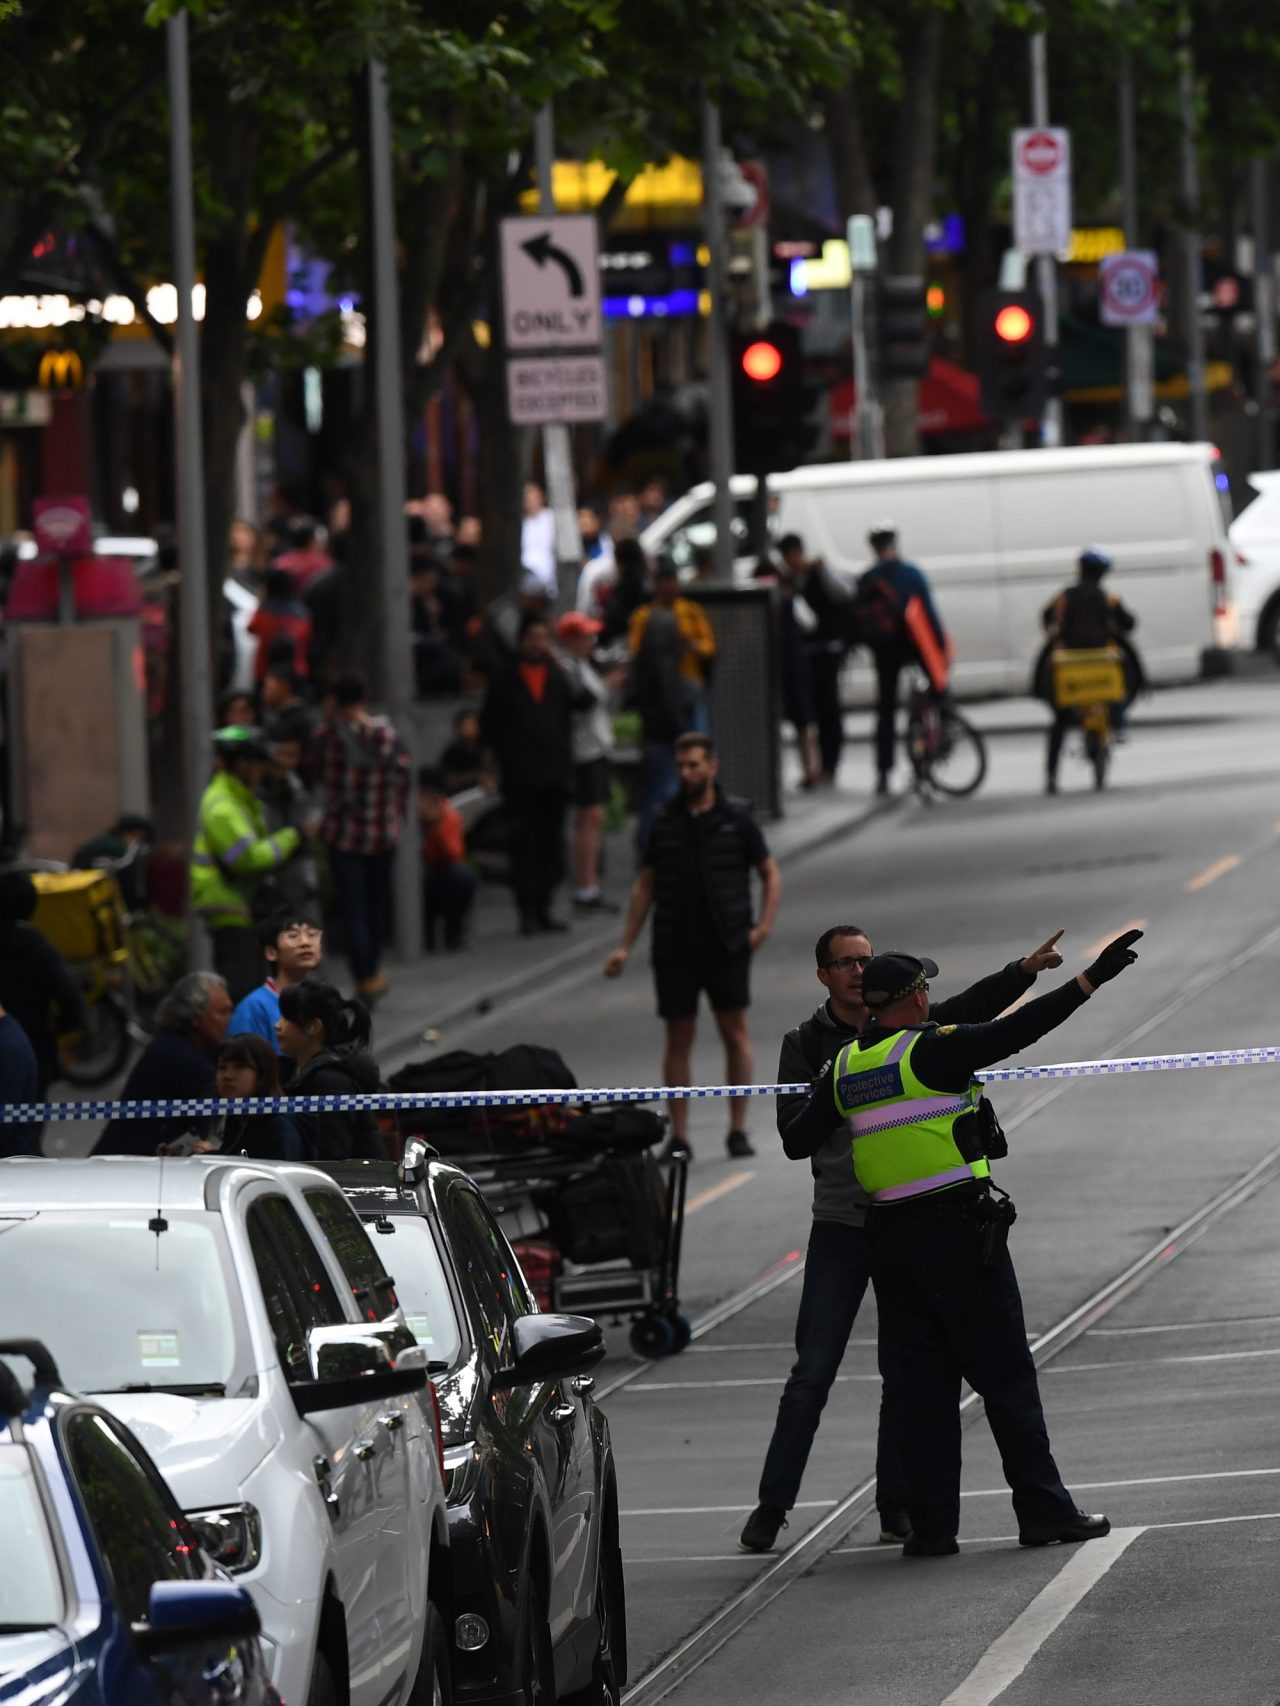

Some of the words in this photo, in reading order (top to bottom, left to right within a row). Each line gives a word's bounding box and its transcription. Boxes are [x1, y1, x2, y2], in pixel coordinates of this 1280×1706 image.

[513, 310, 592, 335] ONLY
[841, 1072, 895, 1096] Protective
[847, 1085, 893, 1105] Services
